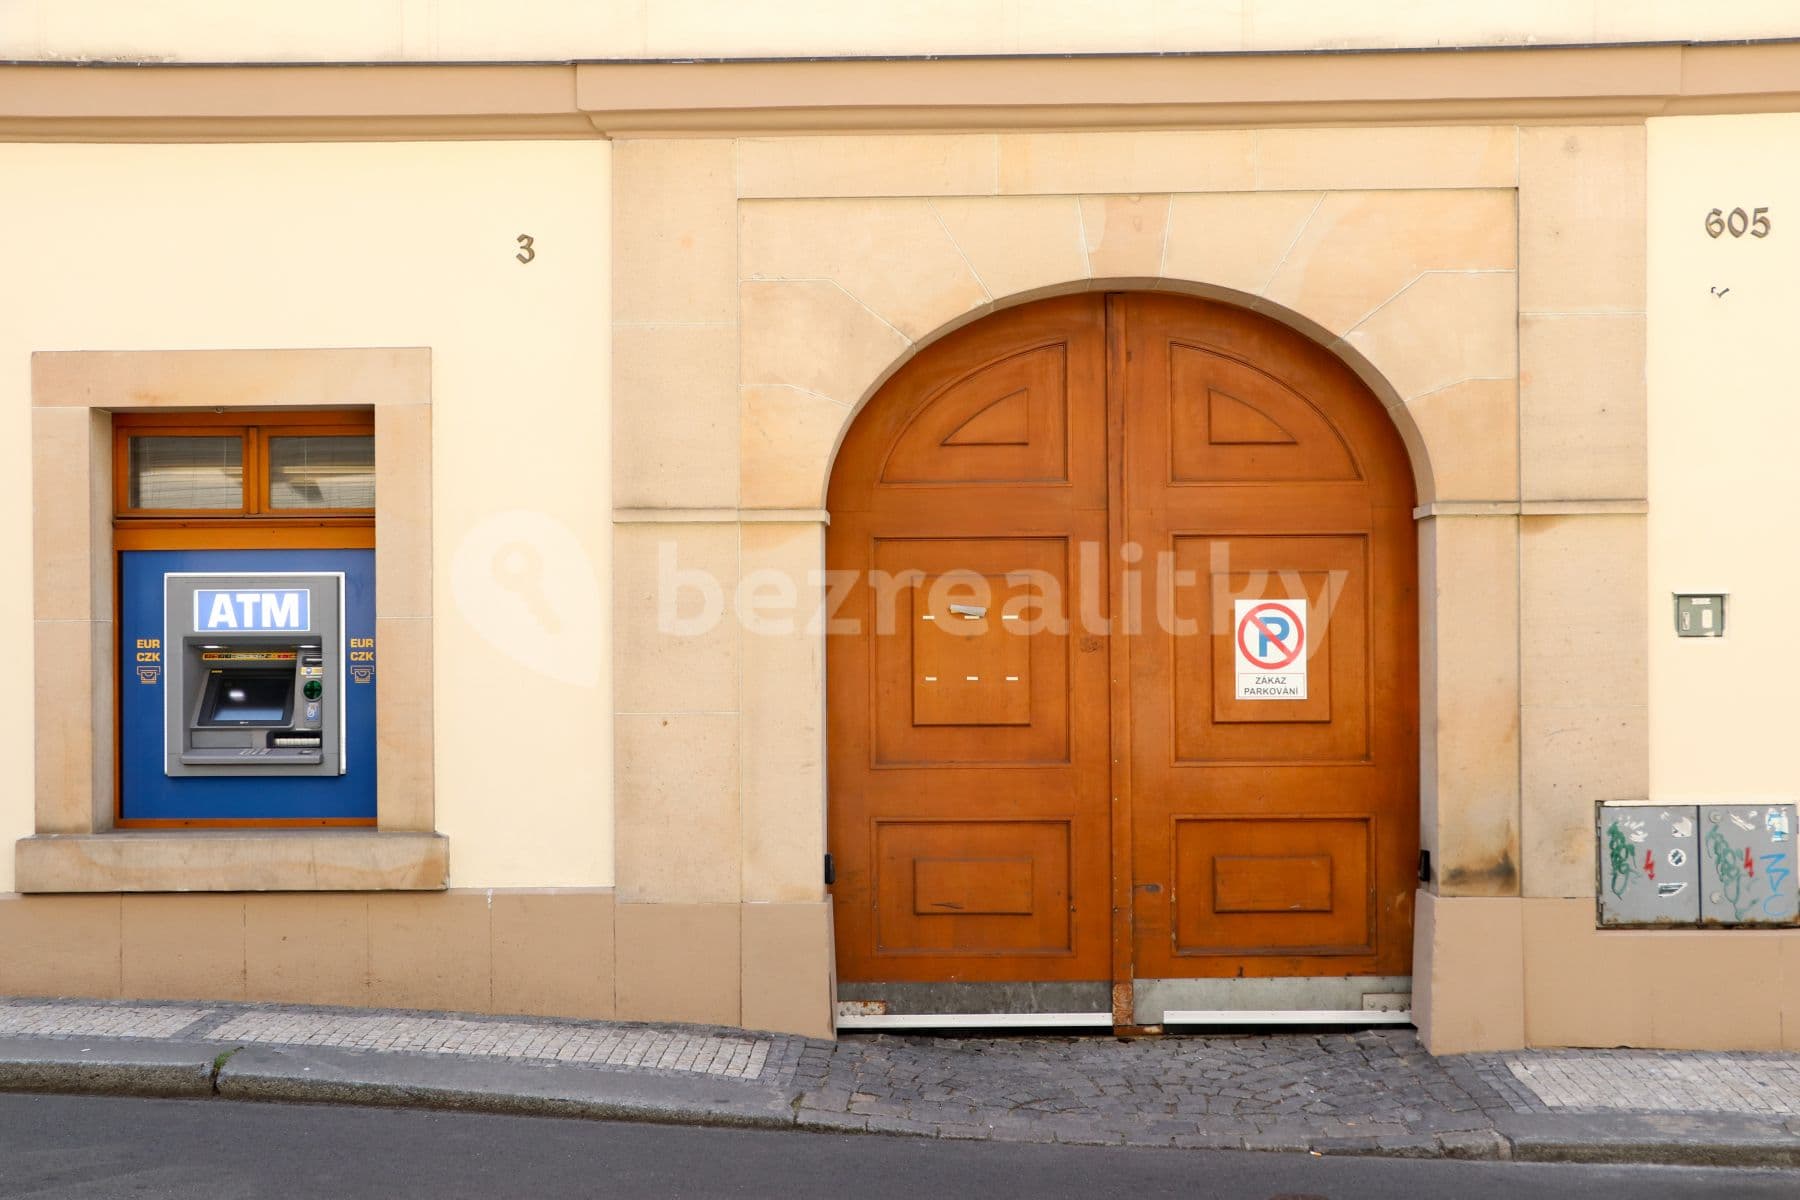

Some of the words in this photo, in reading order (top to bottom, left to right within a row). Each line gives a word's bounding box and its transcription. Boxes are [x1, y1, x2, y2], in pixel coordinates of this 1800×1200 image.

[1705, 206, 1771, 239] 605
[516, 233, 535, 265] 3
[207, 592, 299, 629] ATM
[1258, 616, 1290, 657] P
[136, 639, 161, 649] EUR
[350, 638, 374, 648] EUR
[136, 652, 161, 662] CZK
[350, 651, 375, 661] CZK
[1255, 674, 1287, 685] ZÁKAZ
[1244, 685, 1298, 695] PARKOVÁNÍ
